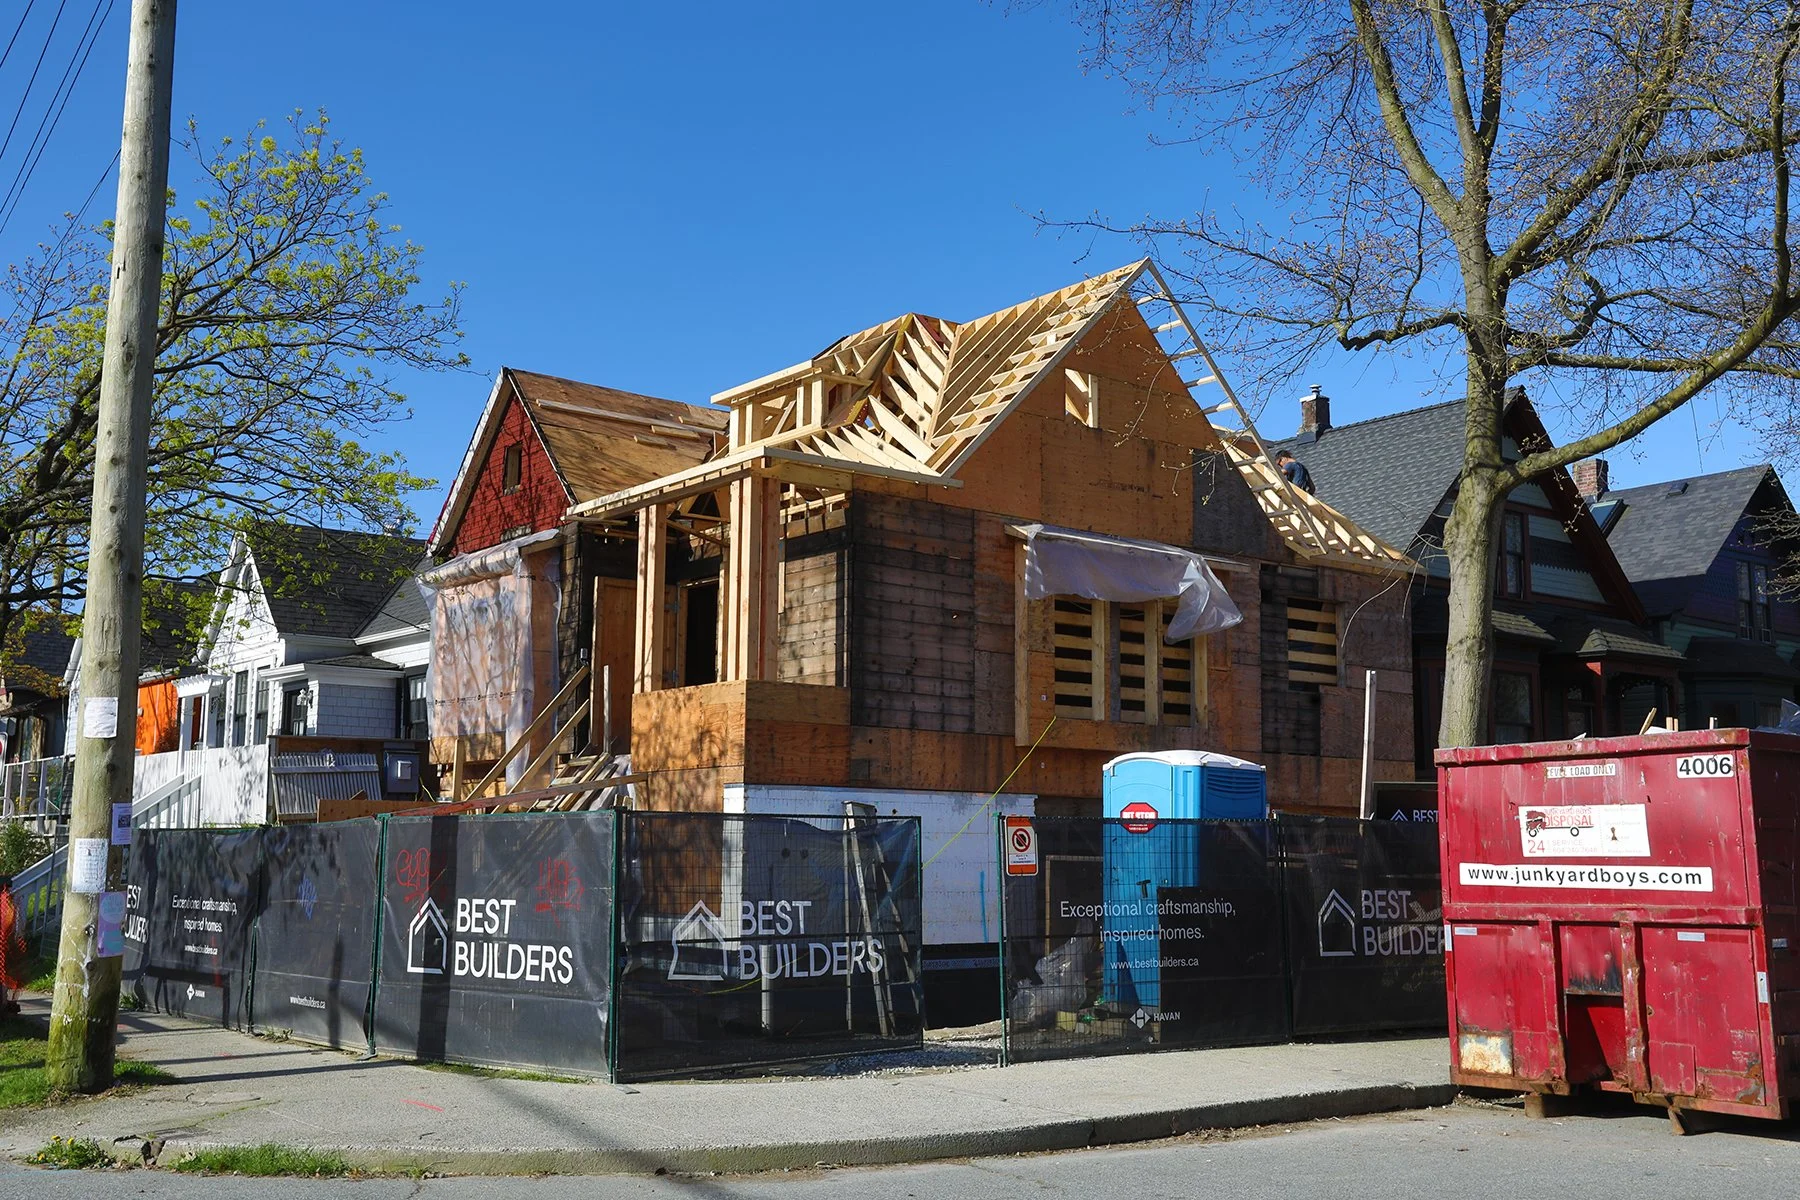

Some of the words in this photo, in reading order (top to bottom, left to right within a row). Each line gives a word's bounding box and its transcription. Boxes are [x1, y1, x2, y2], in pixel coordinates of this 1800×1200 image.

[1549, 767, 1567, 777] EVEL
[1570, 766, 1591, 776] LOAD
[1592, 765, 1615, 775] ONLY
[1679, 756, 1732, 776] 4006
[1544, 815, 1594, 827] DISPOSAL
[1528, 839, 1546, 854] 24
[1467, 866, 1703, 887] www.junkyardboys.com
[126, 884, 142, 909] EST
[1361, 889, 1412, 919] BEST
[456, 897, 517, 935] BEST
[739, 899, 812, 936] BEST
[1060, 899, 1142, 921] Exceptional
[1145, 897, 1237, 918] craftsmanship,
[124, 914, 149, 944] UILDERS
[1100, 924, 1154, 946] inspired
[1158, 923, 1206, 941] homes.
[1362, 925, 1446, 956] BUILDER
[454, 941, 574, 985] BUILDERS
[739, 938, 884, 980] BUILDERS
[1110, 956, 1200, 970] www.bestbuilders.ca
[1153, 1011, 1181, 1023] HAVAN
